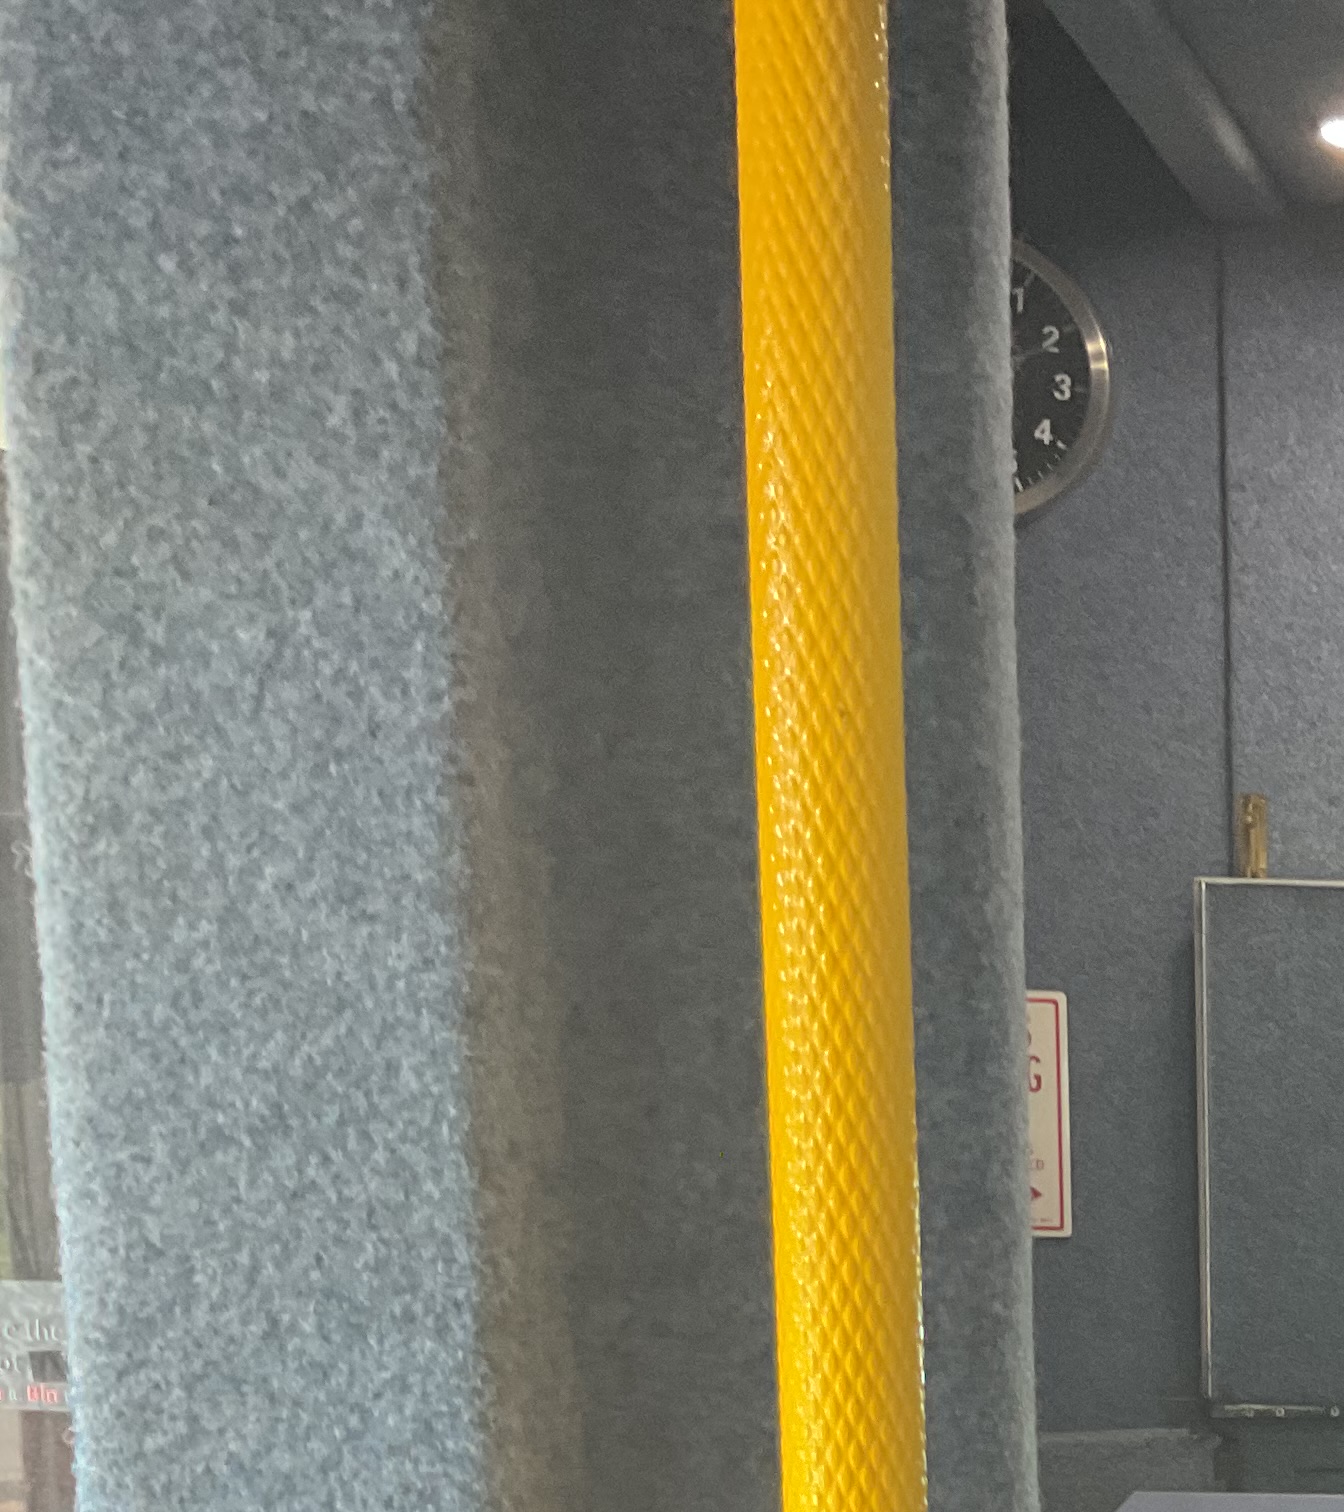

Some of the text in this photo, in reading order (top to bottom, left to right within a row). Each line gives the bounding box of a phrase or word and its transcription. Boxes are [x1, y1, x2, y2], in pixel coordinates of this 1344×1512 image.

[1012, 288, 1025, 314] 1
[1042, 325, 1060, 353] 2
[1053, 373, 1072, 400] 3
[1034, 419, 1054, 445] 4
